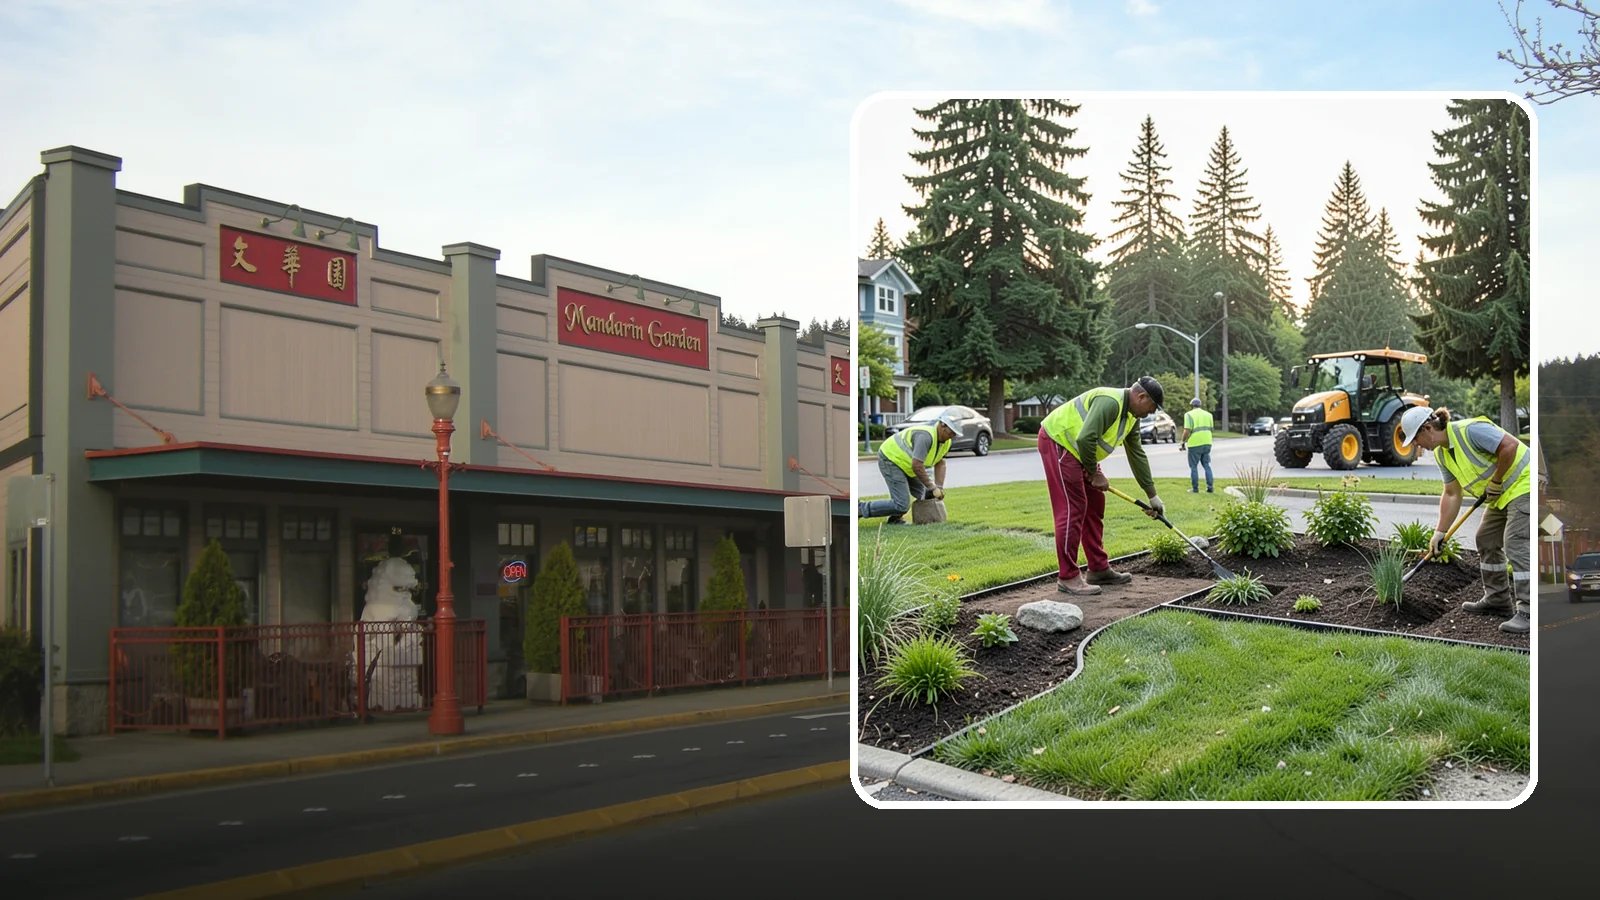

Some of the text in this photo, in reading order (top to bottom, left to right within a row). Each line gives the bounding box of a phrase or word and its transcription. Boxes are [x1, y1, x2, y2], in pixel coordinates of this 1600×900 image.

[231, 236, 346, 291] 文華園
[565, 302, 701, 352] Mandarin Garden
[503, 565, 527, 578] OPEN
